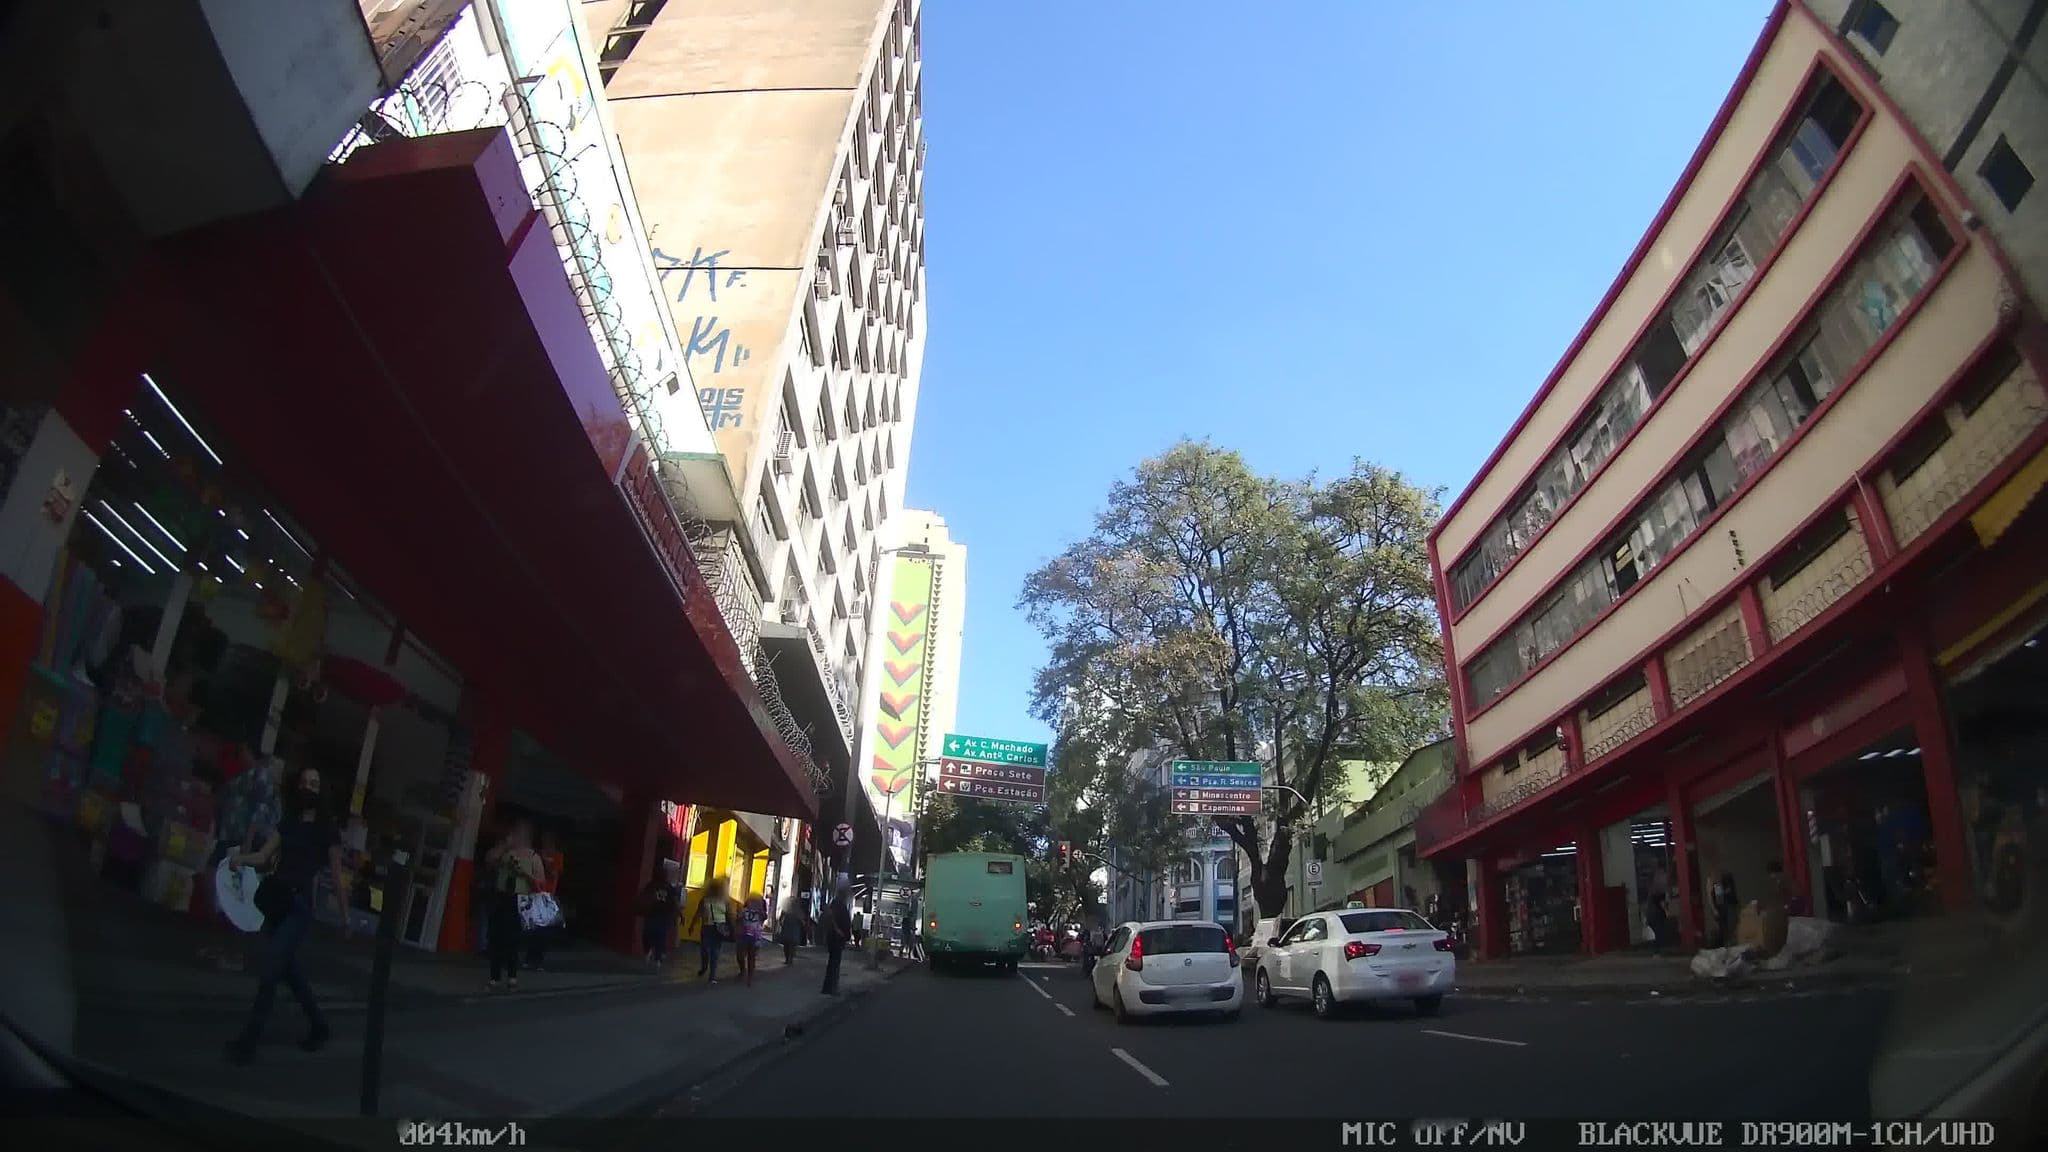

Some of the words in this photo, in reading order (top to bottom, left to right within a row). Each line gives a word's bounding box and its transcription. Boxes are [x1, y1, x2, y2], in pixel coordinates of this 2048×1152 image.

[991, 741, 1033, 754] Machado
[963, 748, 976, 757] Av.
[1006, 753, 1038, 763] Carlos
[1208, 764, 1231, 772] Paulo
[1008, 770, 1032, 780] Sete
[1229, 778, 1257, 786] Soares
[997, 786, 1038, 798] Estação
[1202, 791, 1251, 800] Minascentro
[1201, 803, 1245, 812] Expominas
